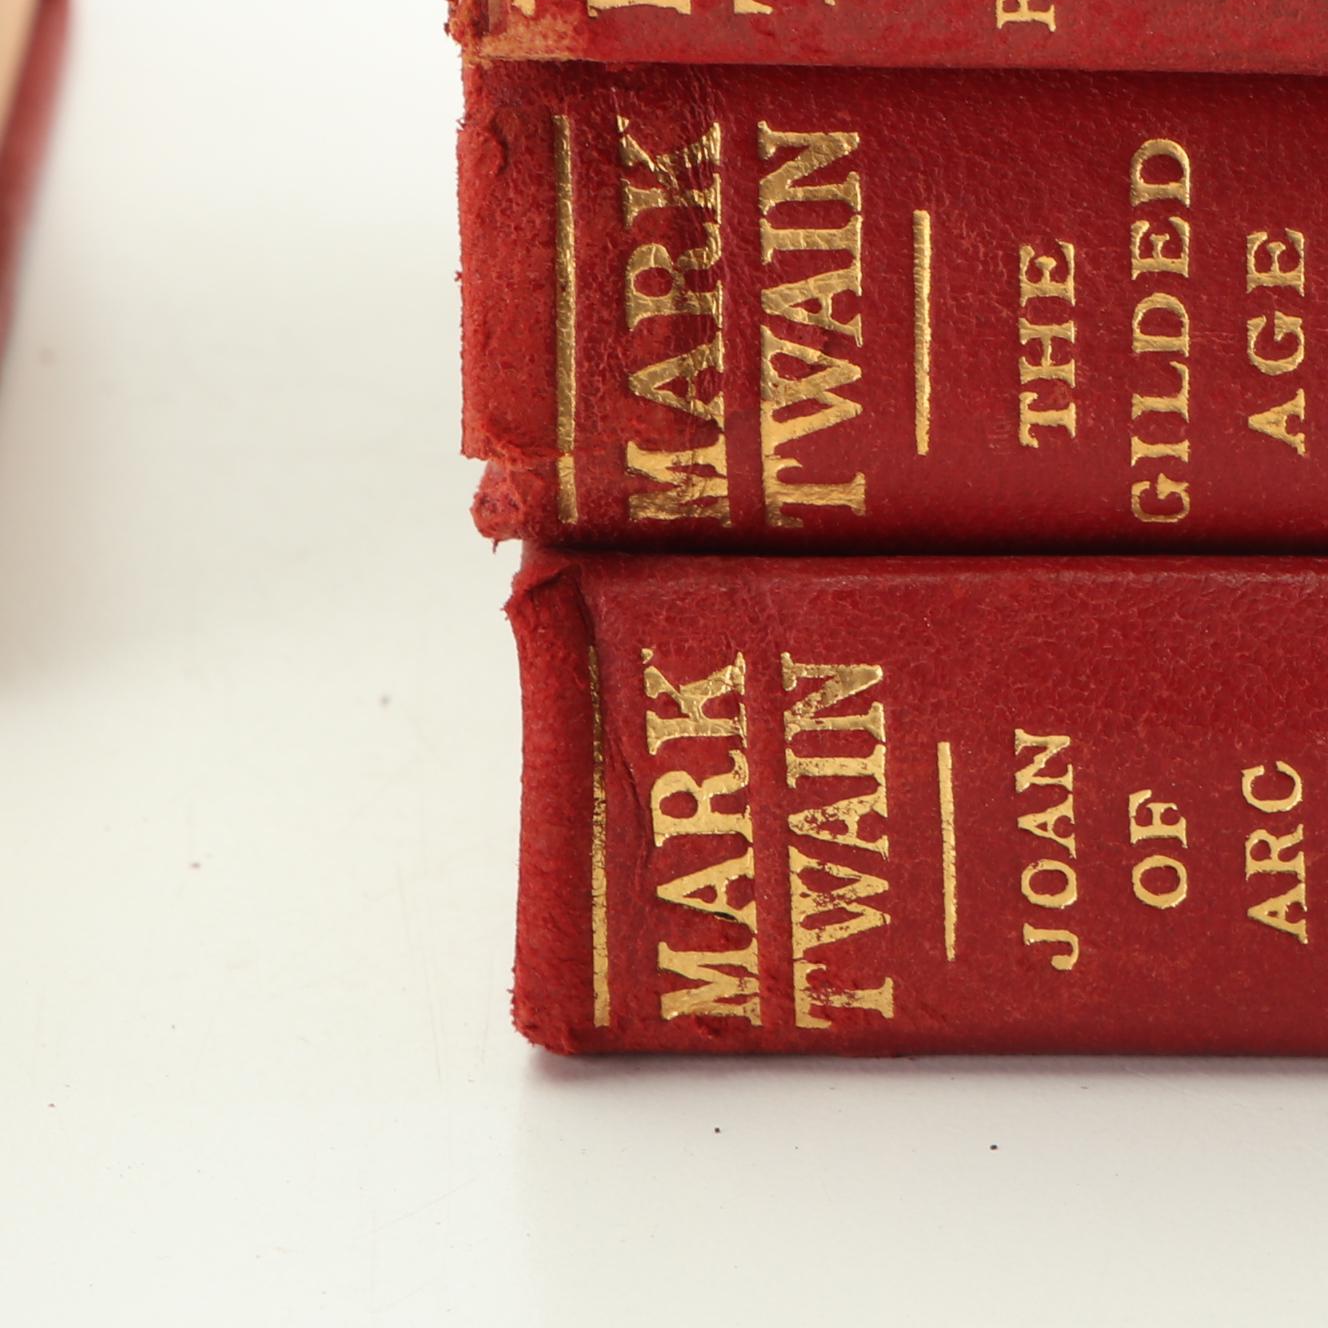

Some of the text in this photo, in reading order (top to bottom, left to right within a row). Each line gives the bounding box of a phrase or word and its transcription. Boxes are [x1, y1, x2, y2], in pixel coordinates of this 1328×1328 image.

[616, 116, 730, 525] MARK
[758, 121, 866, 525] TWAIN
[1019, 242, 1077, 448] THE
[1130, 139, 1192, 522] GILDED
[1247, 229, 1306, 455] AGE
[641, 647, 761, 1026] MARK
[781, 652, 894, 1029] TWAIN
[1014, 729, 1080, 971] JOAN
[1128, 789, 1189, 909] OF
[1241, 761, 1309, 945] ARC
